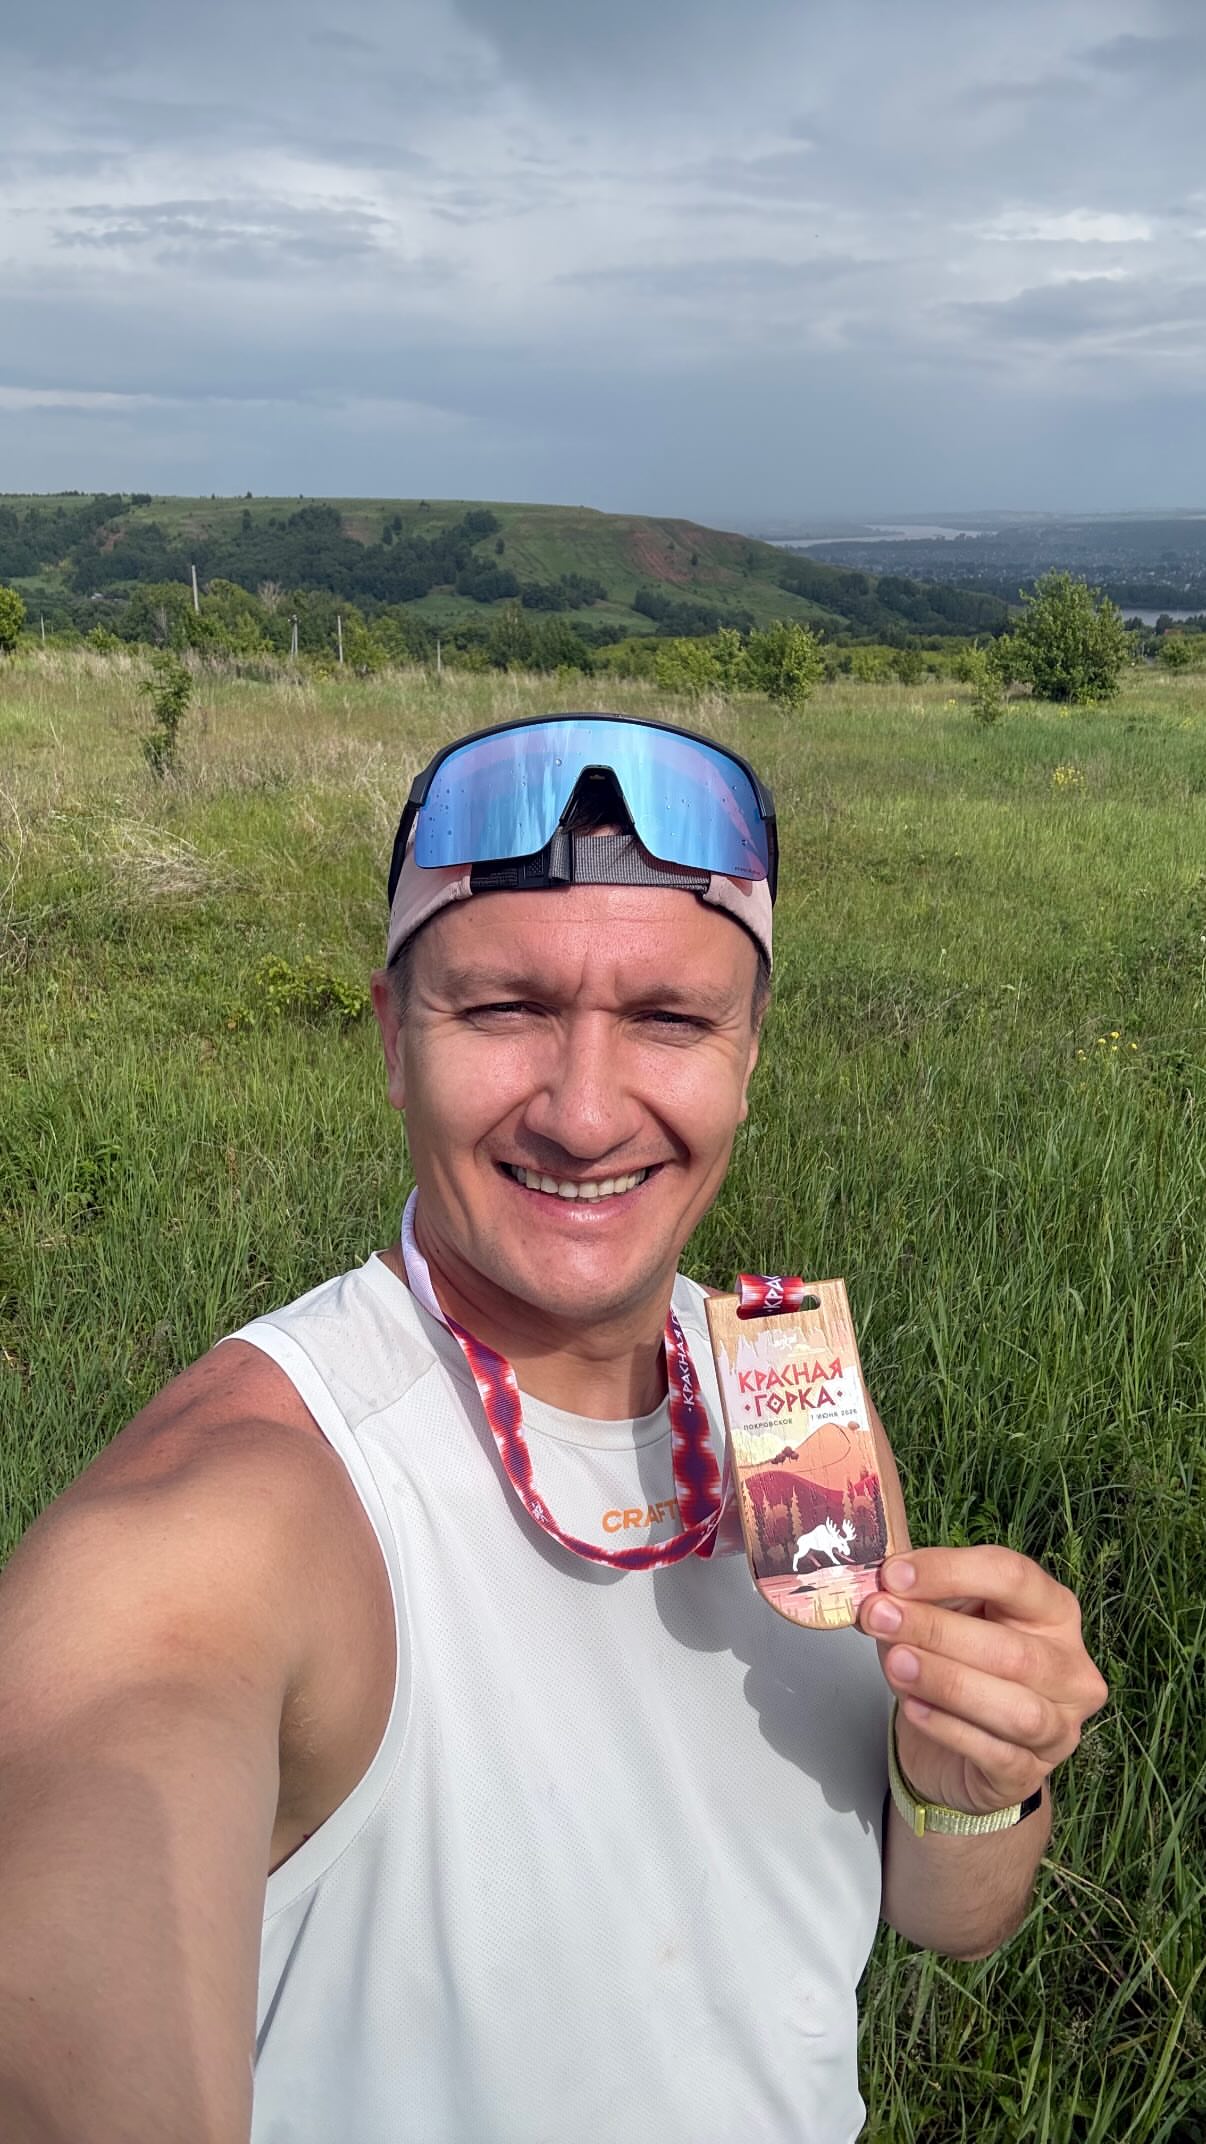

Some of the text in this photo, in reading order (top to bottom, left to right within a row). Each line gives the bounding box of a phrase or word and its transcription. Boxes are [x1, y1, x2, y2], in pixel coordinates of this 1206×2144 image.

[738, 1357, 843, 1393] КРАСНАЯ
[754, 1385, 836, 1417] ГОРКА
[743, 1418, 793, 1431] ПОКРОВСКОЕ
[602, 1499, 679, 1534] CRAFT
